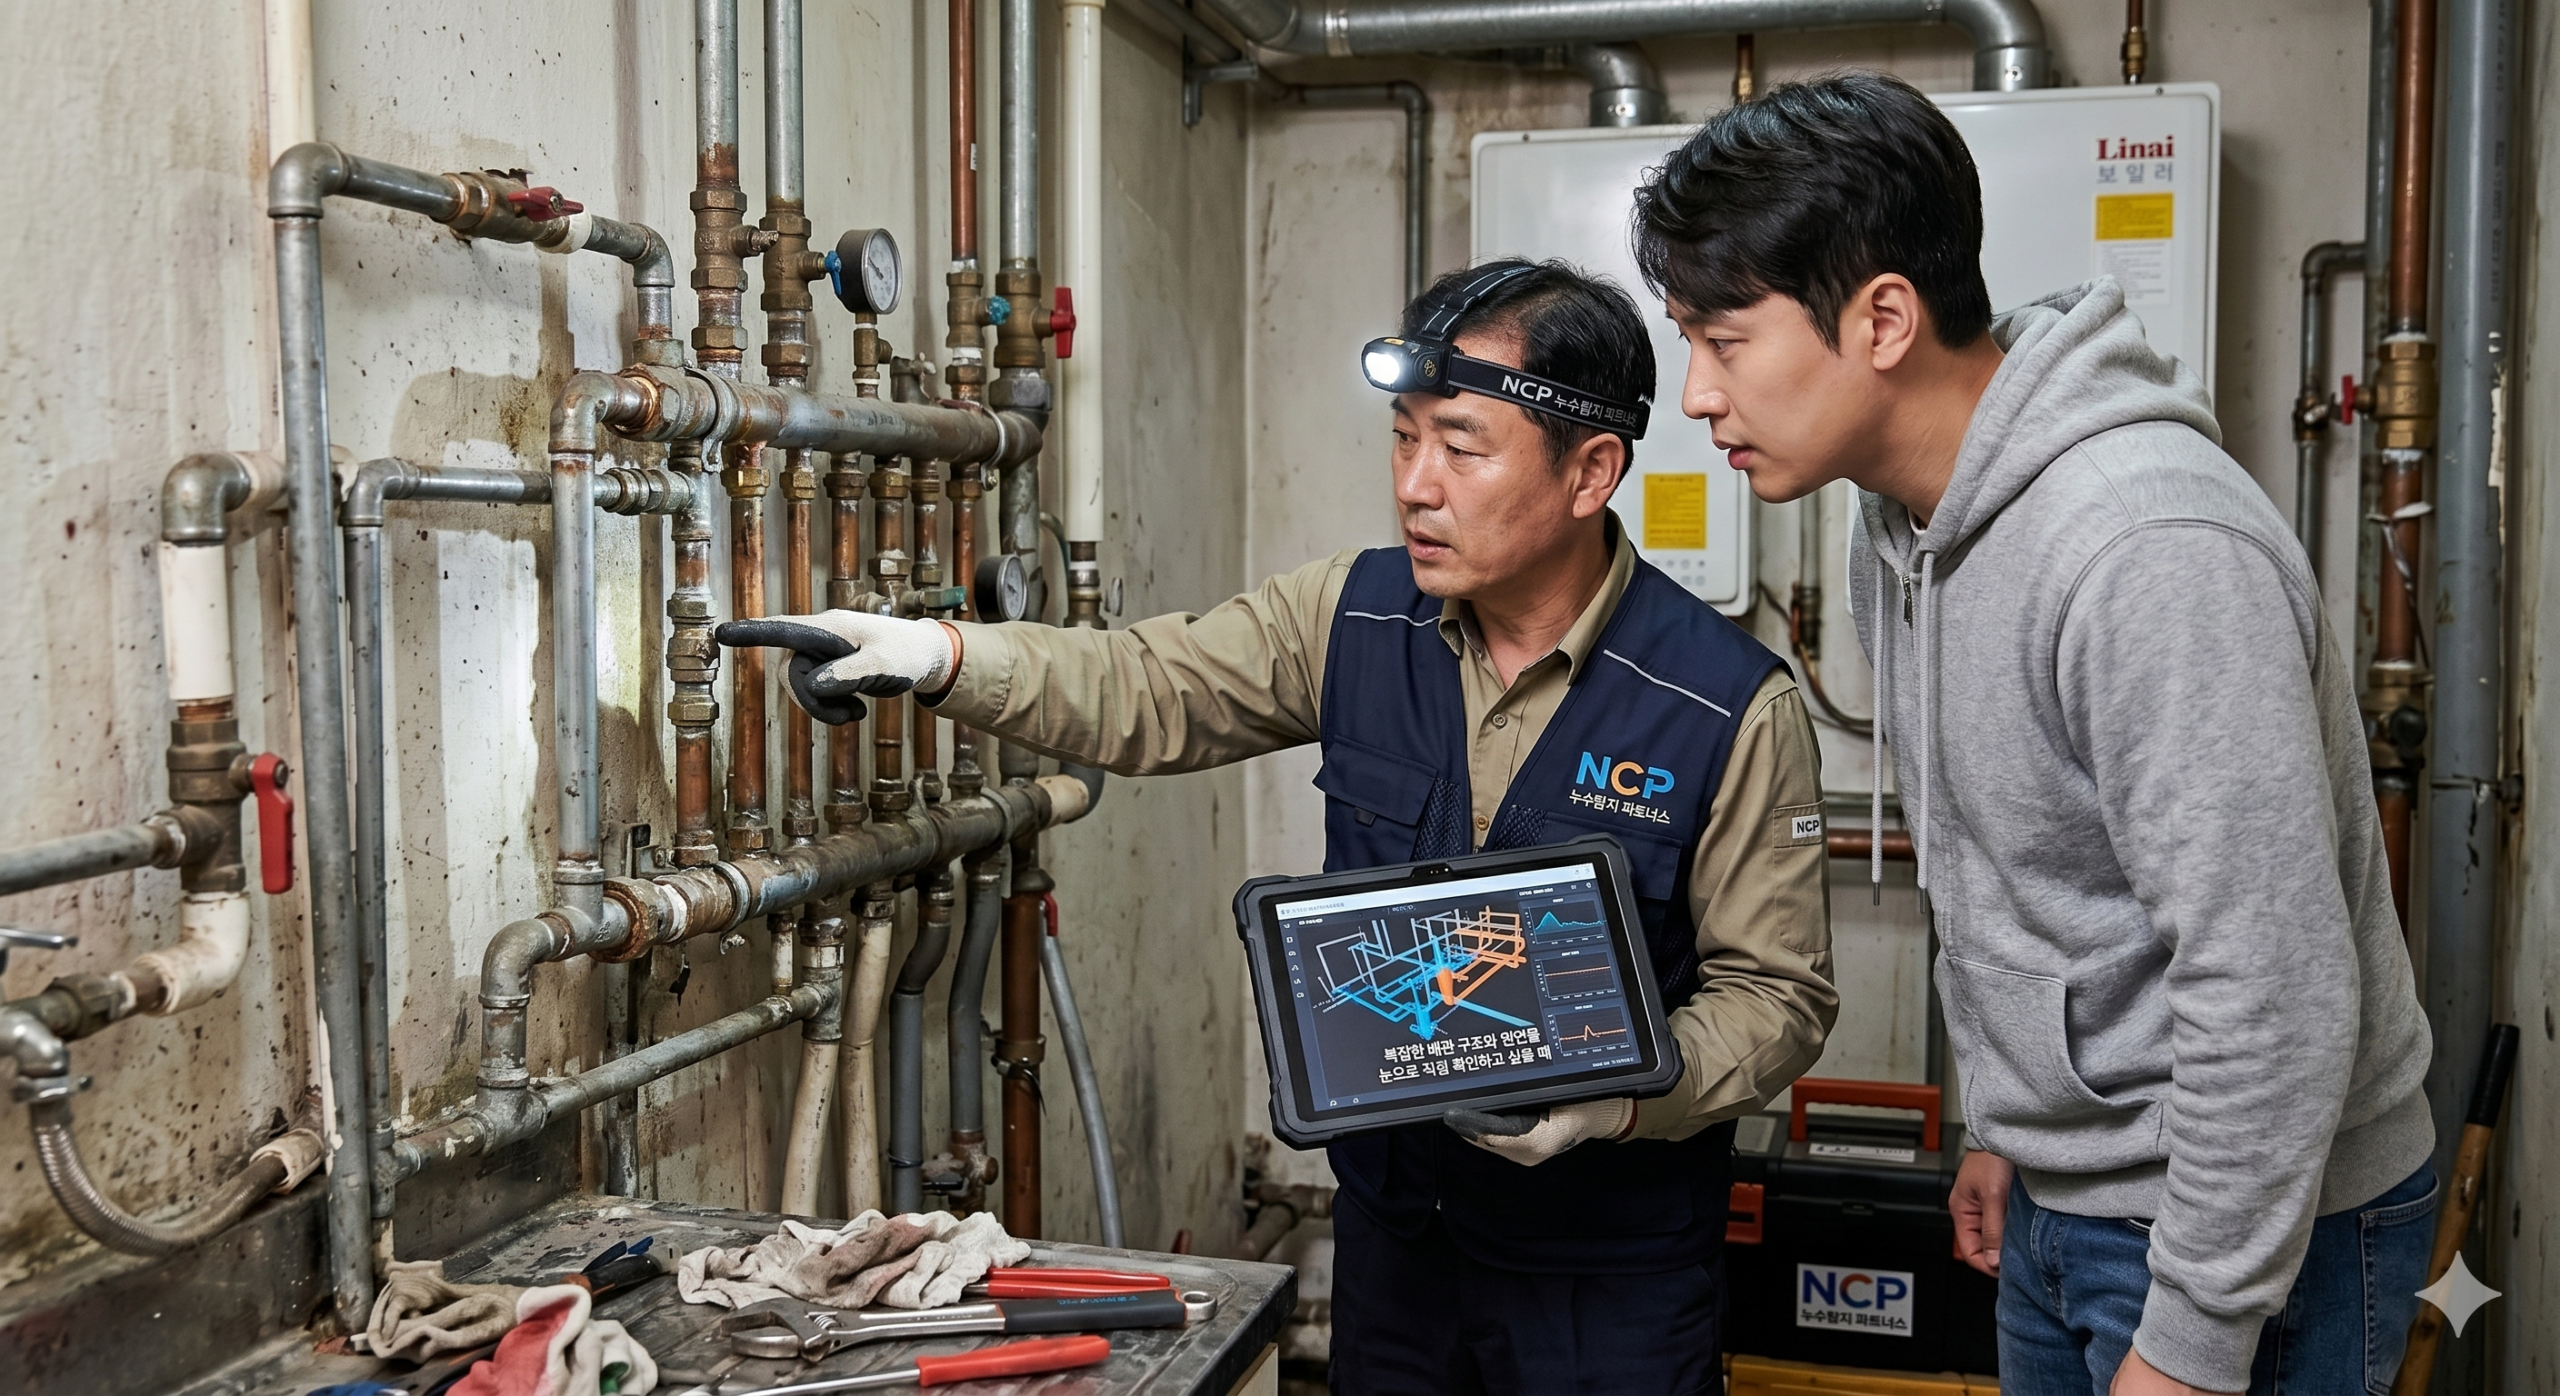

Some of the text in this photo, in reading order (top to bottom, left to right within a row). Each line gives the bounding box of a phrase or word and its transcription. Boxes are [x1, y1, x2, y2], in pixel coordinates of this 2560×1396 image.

[2096, 135, 2175, 161] Linai
[2097, 161, 2174, 184] 보일러
[1501, 375, 1553, 402] NCP
[1575, 751, 1675, 799] NCP
[1796, 819, 1820, 834] NCP
[1384, 1043, 1425, 1063] 복잡한
[1427, 1039, 1455, 1057] 배관
[1457, 1033, 1498, 1053] 구조와
[1379, 1064, 1420, 1084] 눈으로
[1452, 1052, 1506, 1073] 확인하고
[1508, 1047, 1535, 1066] 싶을
[1537, 1044, 1553, 1061] 때
[1802, 1269, 1908, 1311] NCP
